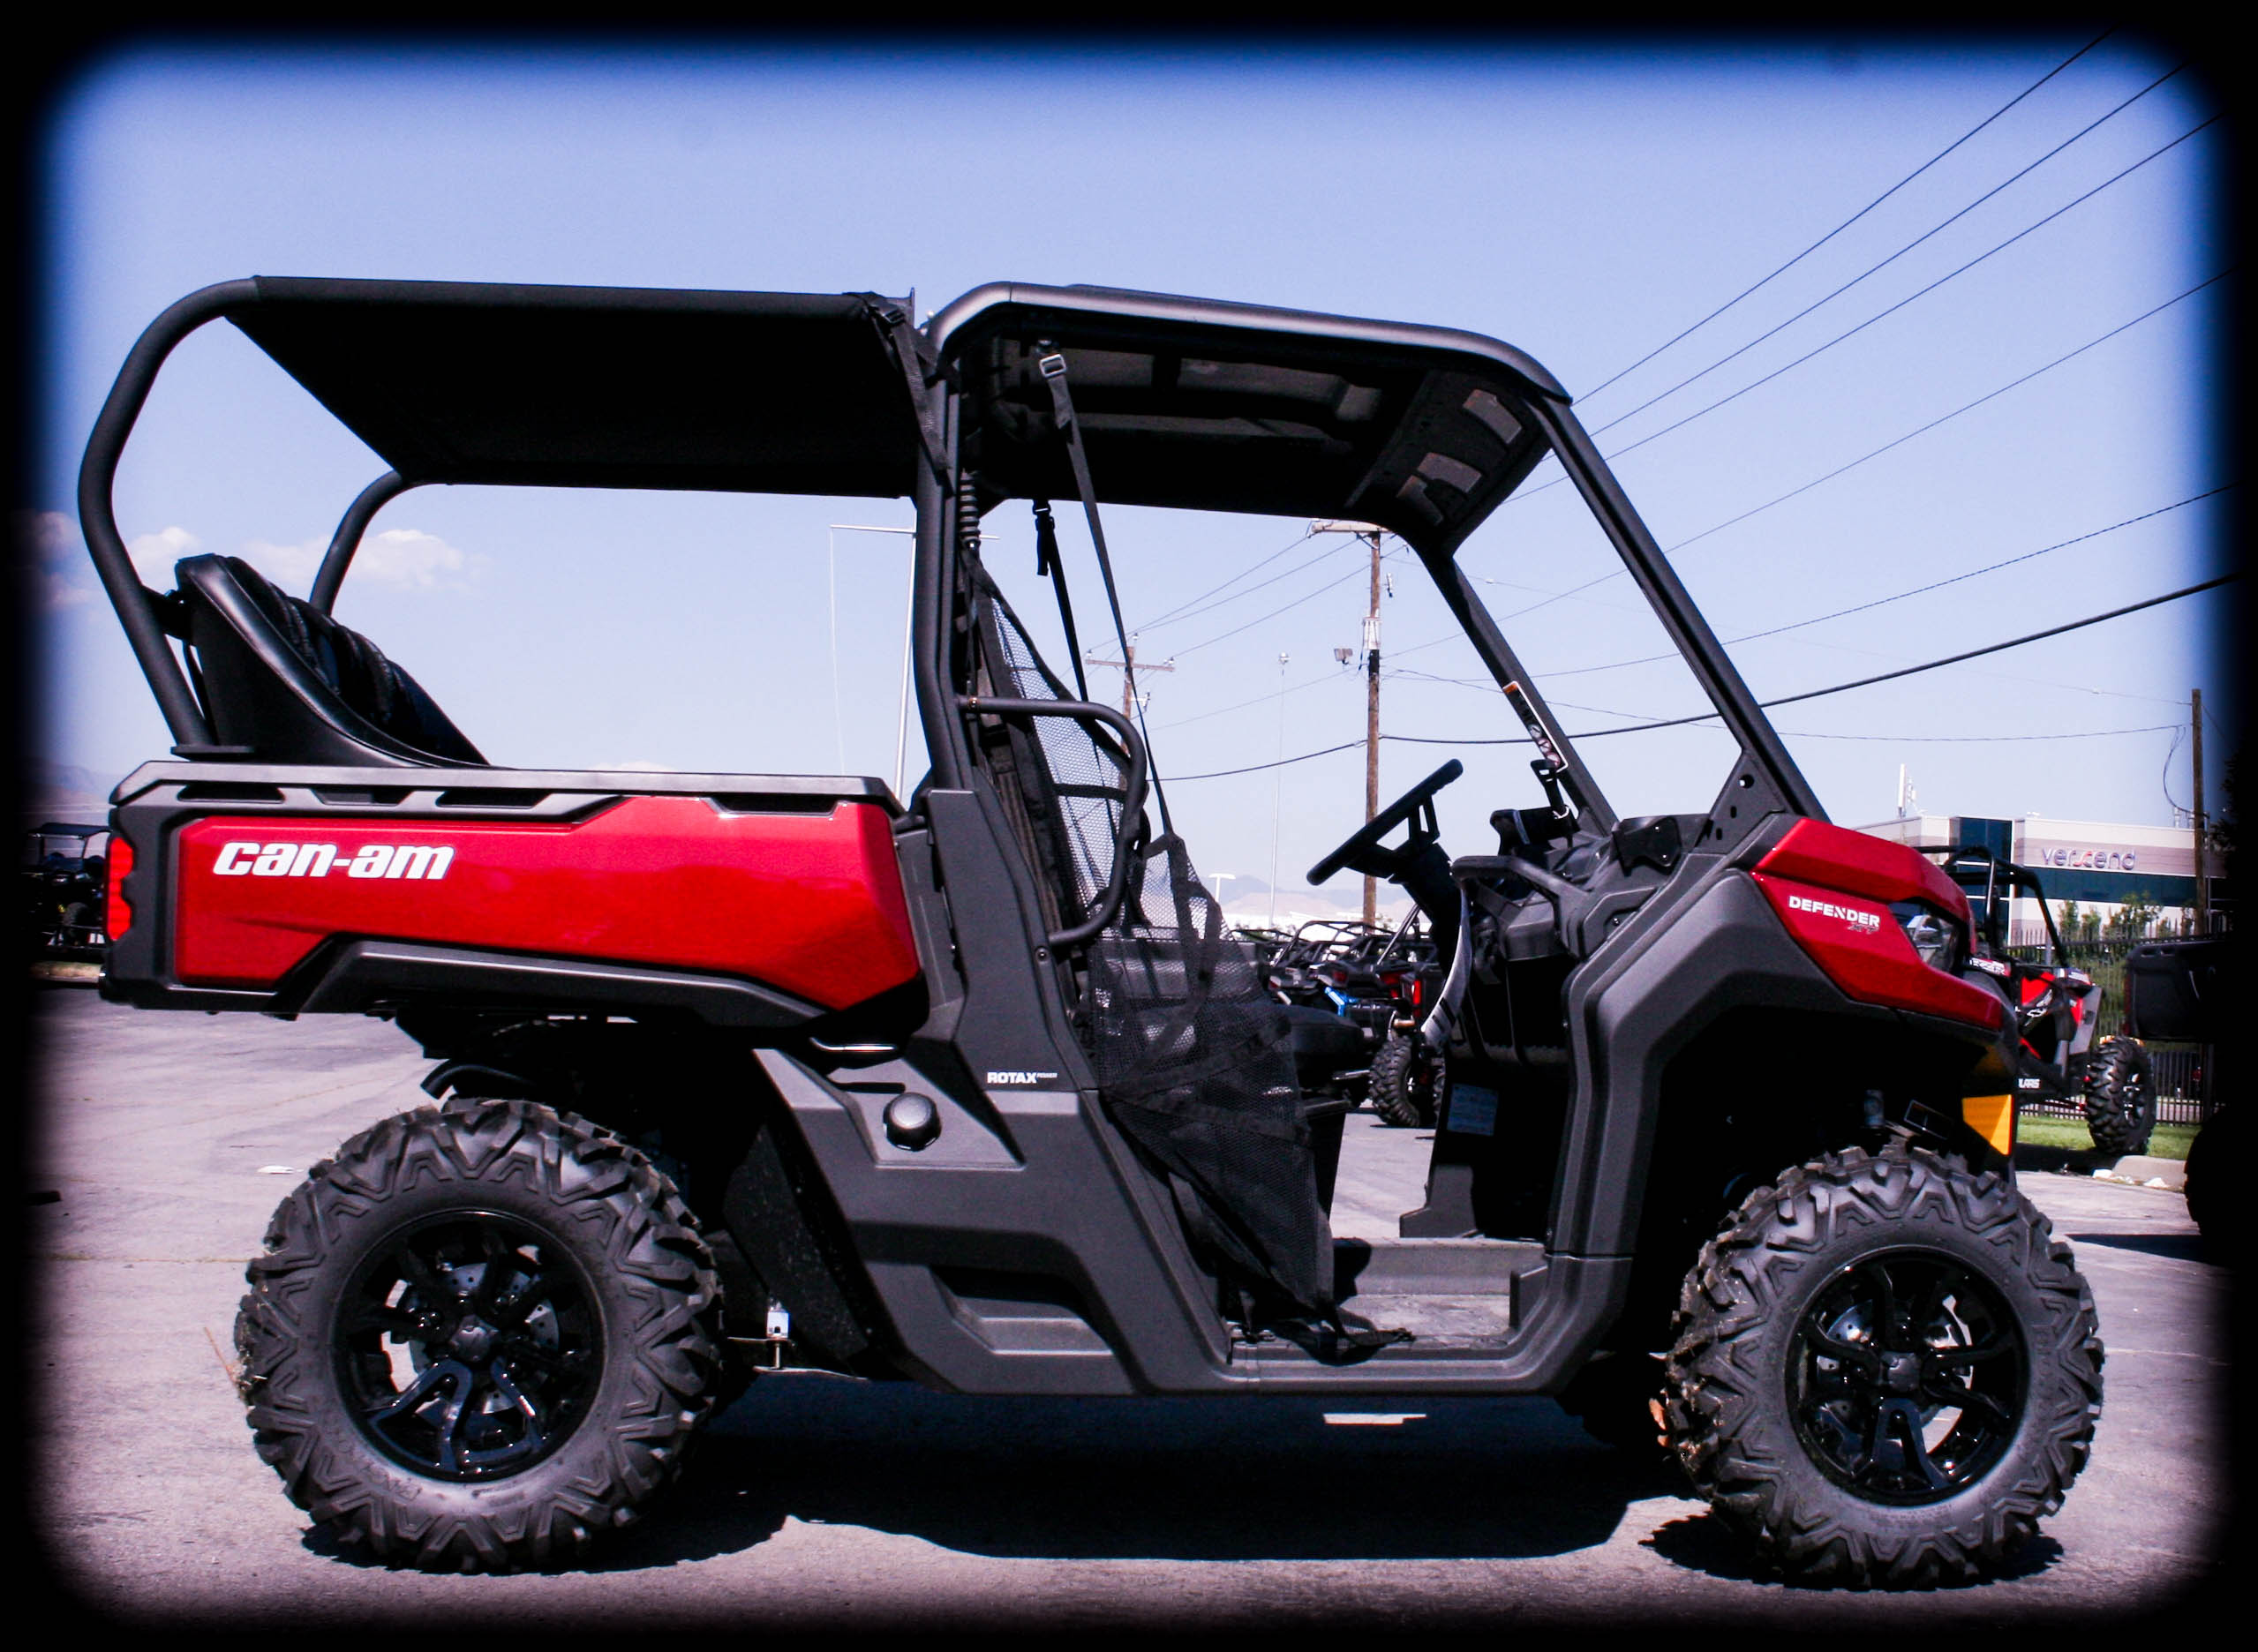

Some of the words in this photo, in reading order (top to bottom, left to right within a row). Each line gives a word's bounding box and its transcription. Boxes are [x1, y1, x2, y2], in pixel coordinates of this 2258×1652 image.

[213, 841, 455, 880] can-am
[2042, 847, 2136, 871] verscend
[1788, 895, 1881, 927] DEFENDER
[987, 1071, 1037, 1084] ROTAX
